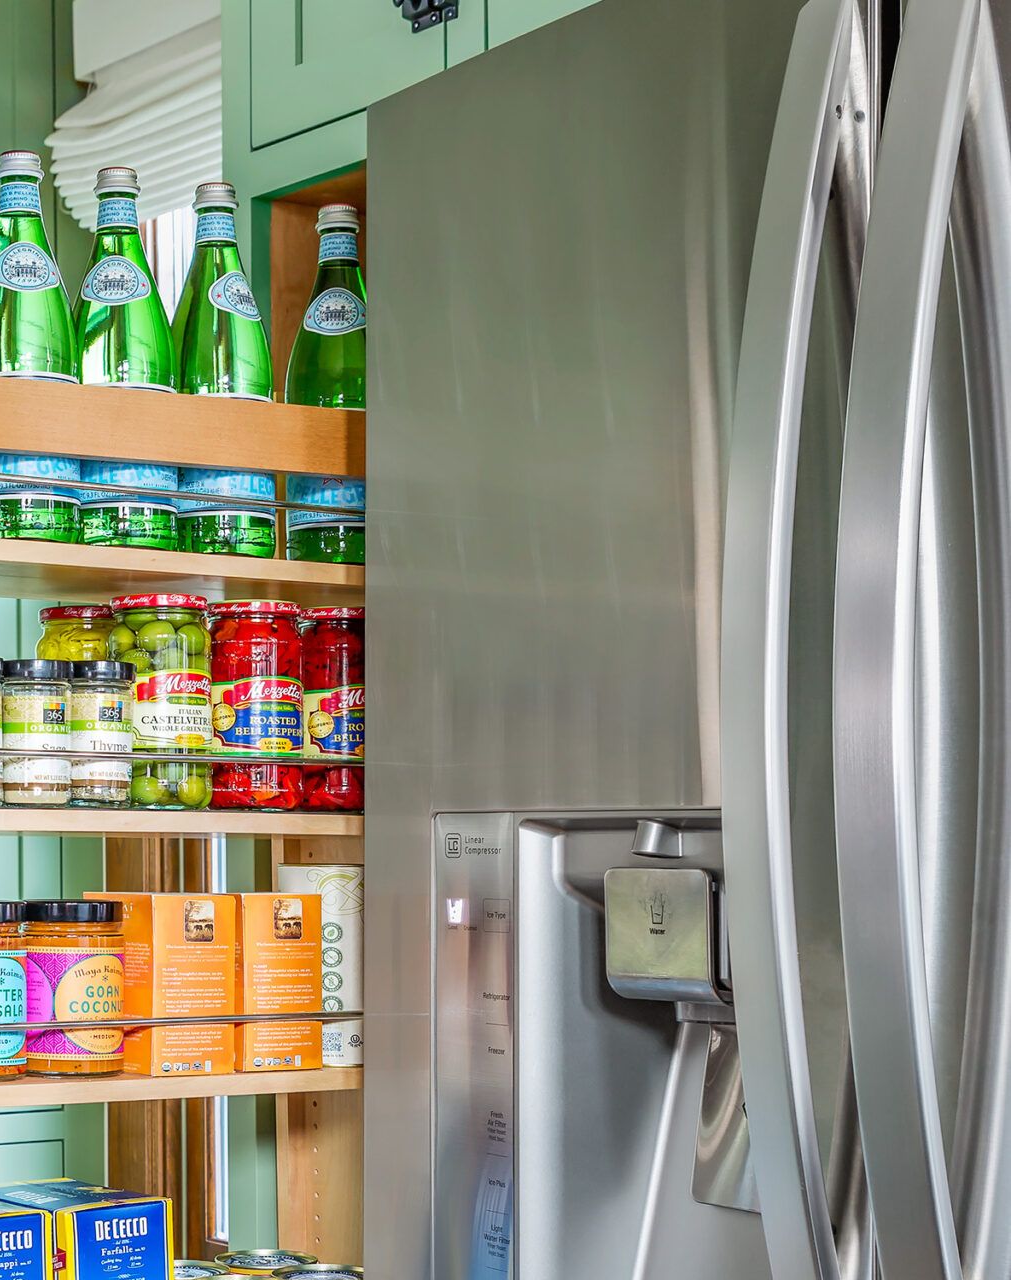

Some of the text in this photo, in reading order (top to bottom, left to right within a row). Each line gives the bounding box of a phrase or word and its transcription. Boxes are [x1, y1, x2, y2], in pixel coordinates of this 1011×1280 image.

[155, 674, 211, 694] Mezzetta
[241, 681, 300, 701] Mezzetta
[47, 710, 63, 720] 365
[103, 709, 120, 719] 365
[250, 715, 297, 726] ROASTED
[30, 725, 70, 733] ORGANIC
[86, 722, 131, 731] ORGANIC
[180, 725, 201, 733] GREEN
[235, 727, 264, 736] BELL
[334, 733, 363, 743] BELL
[464, 836, 485, 844] Linear
[464, 846, 502, 856] Compressor
[486, 911, 507, 920] Ice Type
[75, 968, 101, 978] Maya
[86, 985, 120, 998] GOAN
[483, 991, 511, 1001] Refrigerator
[487, 1046, 506, 1056] Freezer
[490, 1110, 504, 1119] Fresh
[488, 1178, 506, 1188] Ice Plus
[490, 1224, 504, 1234] Light
[484, 1233, 498, 1242] Water
[101, 1246, 133, 1256] Farfalle
